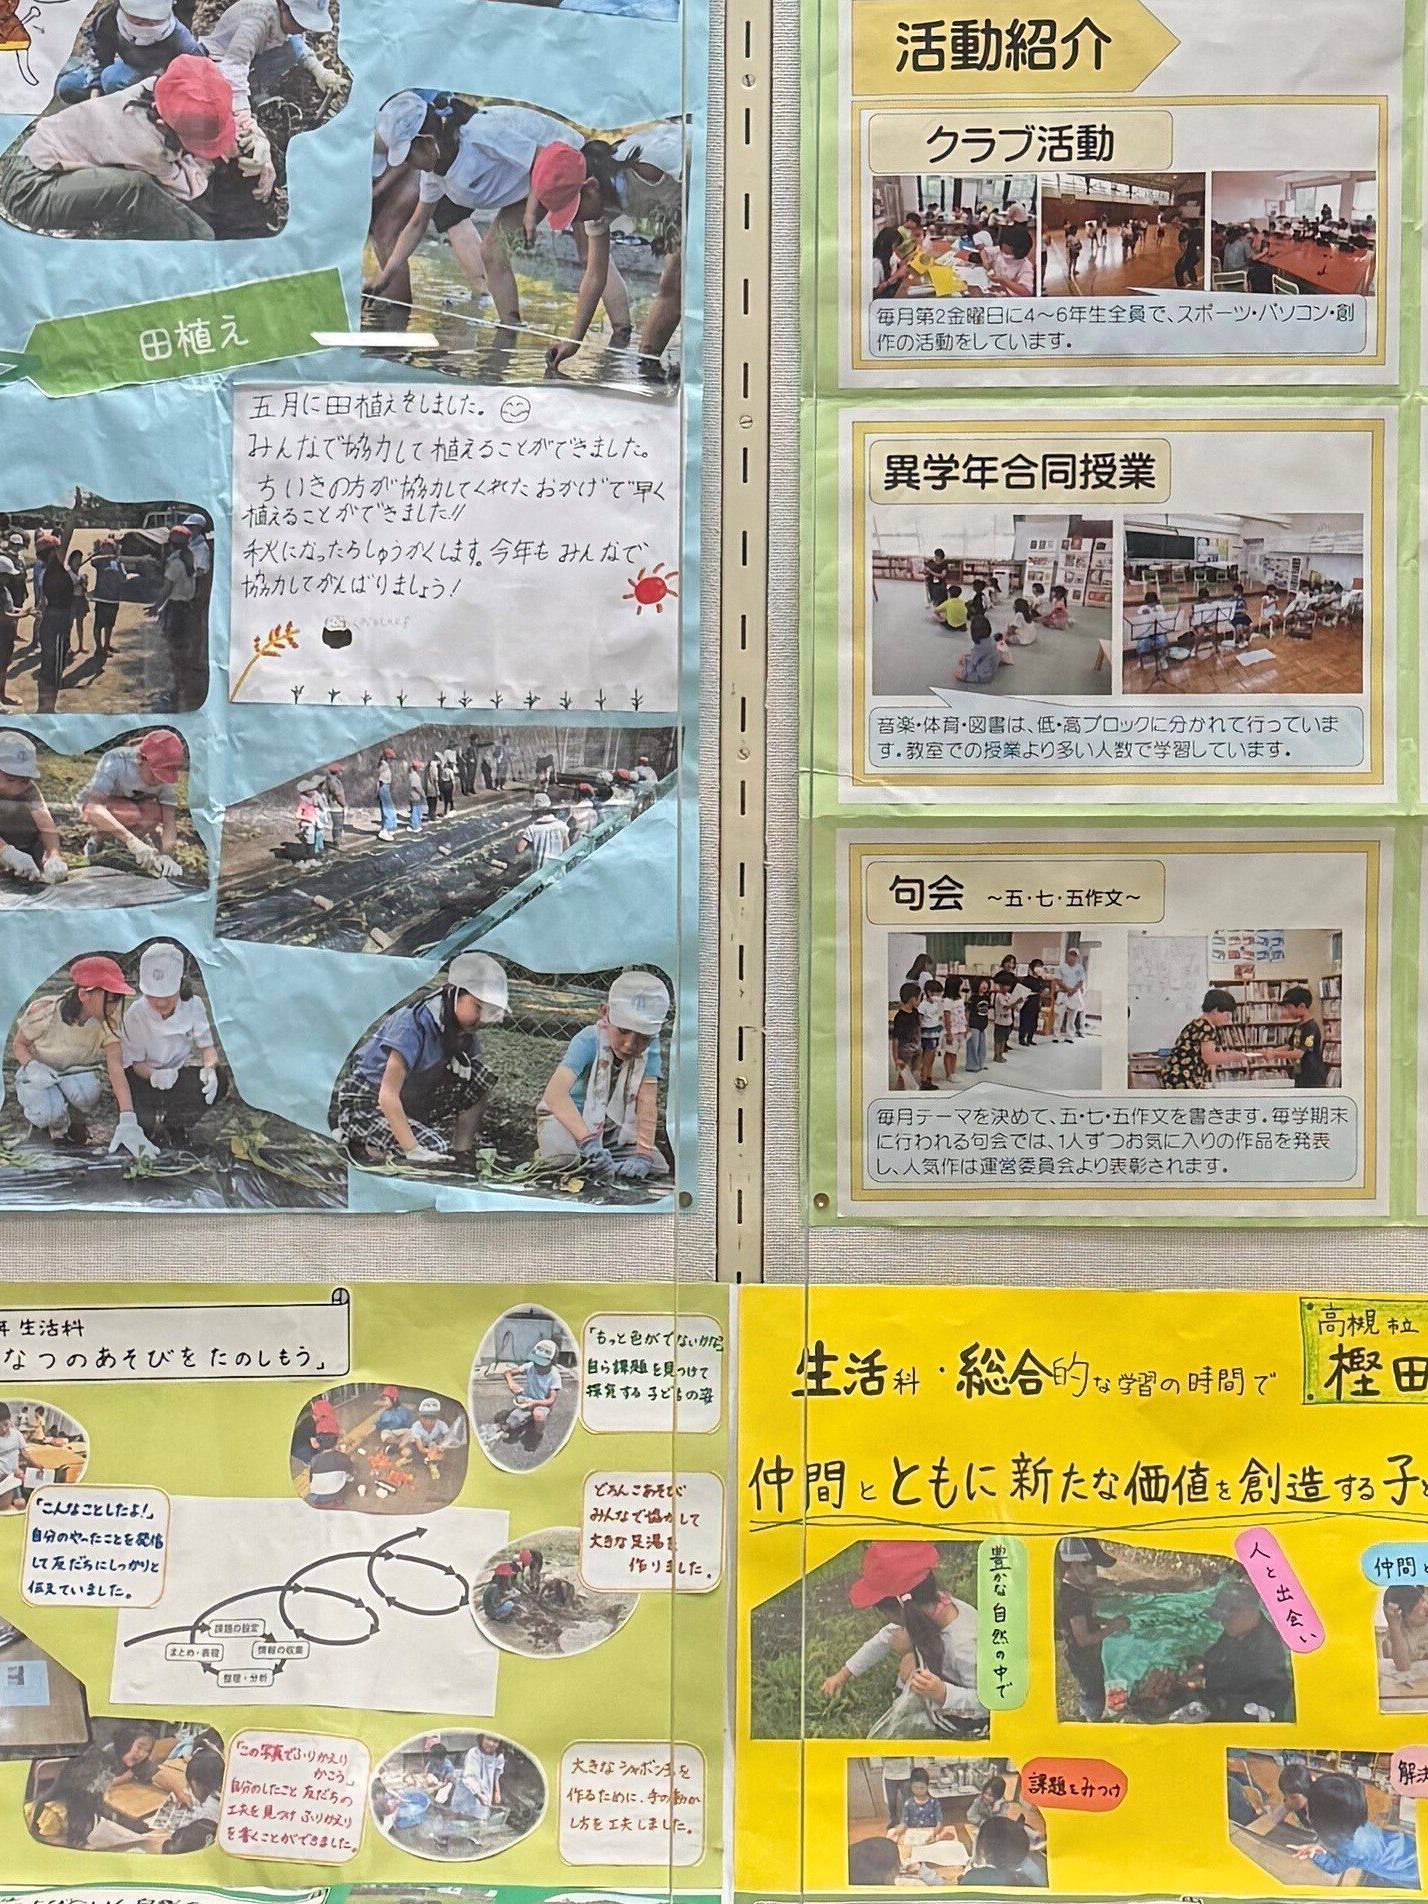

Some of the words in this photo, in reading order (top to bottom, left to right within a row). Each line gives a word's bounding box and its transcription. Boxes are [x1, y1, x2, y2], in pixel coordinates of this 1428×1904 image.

[895, 17, 1113, 73] 活動紹介
[925, 122, 1114, 163] クラブ活動
[139, 314, 249, 363] 田植え
[876, 331, 1073, 353] 作の活動をしています。
[249, 391, 485, 421] 五月に田植えをしました。
[884, 452, 1156, 491] 異学年合同授業
[878, 739, 1292, 761] す。教室での授業より多い人数で学習しています。
[889, 874, 964, 911] 句会
[1249, 1541, 1318, 1644] 人と出会い
[989, 1544, 1017, 1699] 豊かな自然の中で
